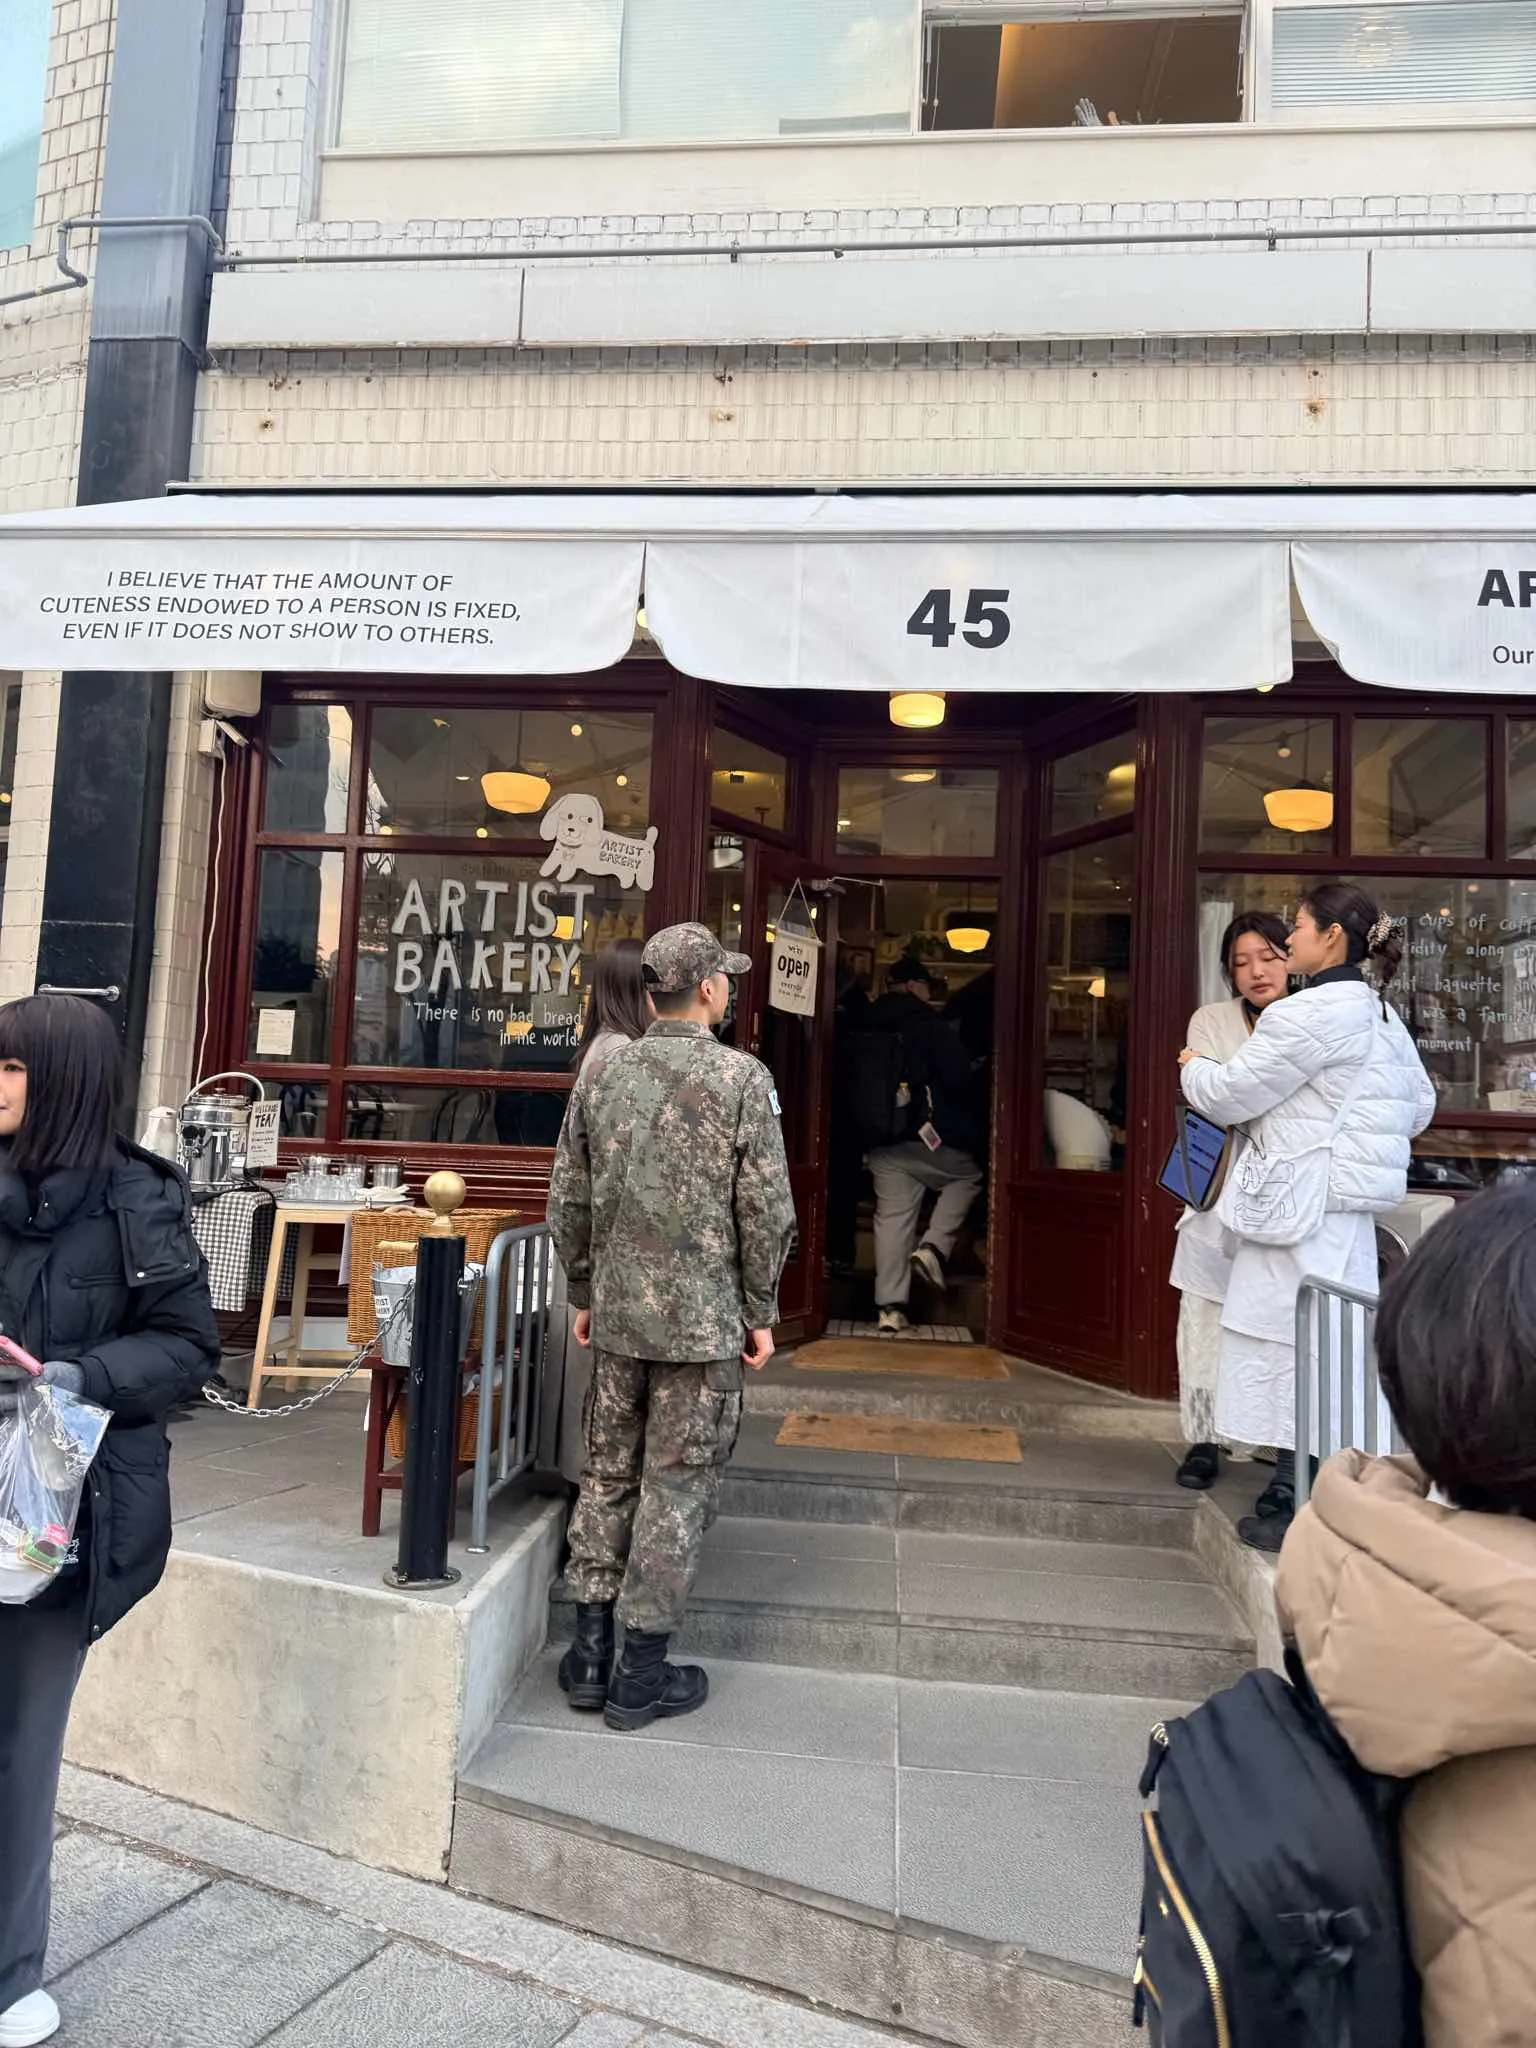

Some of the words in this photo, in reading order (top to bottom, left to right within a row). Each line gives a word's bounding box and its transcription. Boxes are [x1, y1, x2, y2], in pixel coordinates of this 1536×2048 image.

[107, 571, 114, 587] I
[118, 570, 208, 589] BELIEVE
[212, 573, 269, 591] THAT
[272, 573, 314, 590] THE
[317, 572, 418, 591] AMOUNT
[422, 574, 454, 592] OF
[39, 596, 151, 614] CUTENESS
[156, 596, 270, 615] ENDOWED
[275, 597, 304, 615] TO
[308, 597, 323, 614] A
[329, 597, 421, 618] PERSON
[427, 600, 448, 618] IS
[453, 601, 521, 622] FIXED,
[906, 588, 1011, 649] 45
[62, 622, 120, 640] EVEN
[124, 621, 144, 639] IF
[147, 621, 169, 639] IT
[172, 622, 233, 641] DOES
[238, 623, 286, 641] NOT
[288, 621, 359, 640] SHOW
[363, 623, 393, 642] TO
[399, 625, 495, 646] OTHERS.
[1492, 644, 1535, 665] Our
[600, 838, 645, 857] ARTIST
[599, 850, 642, 870] BAKERY
[391, 878, 596, 941] ARTIST
[1468, 912, 1488, 932] of
[1465, 937, 1505, 963] along
[393, 939, 583, 997] BAKERY
[777, 954, 810, 979] open
[1433, 972, 1501, 994] baguette
[471, 1005, 481, 1023] is
[487, 1007, 504, 1022] no
[510, 1002, 534, 1023] bad
[543, 1002, 582, 1026] bread
[1455, 1006, 1467, 1022] a
[499, 1028, 511, 1046] in
